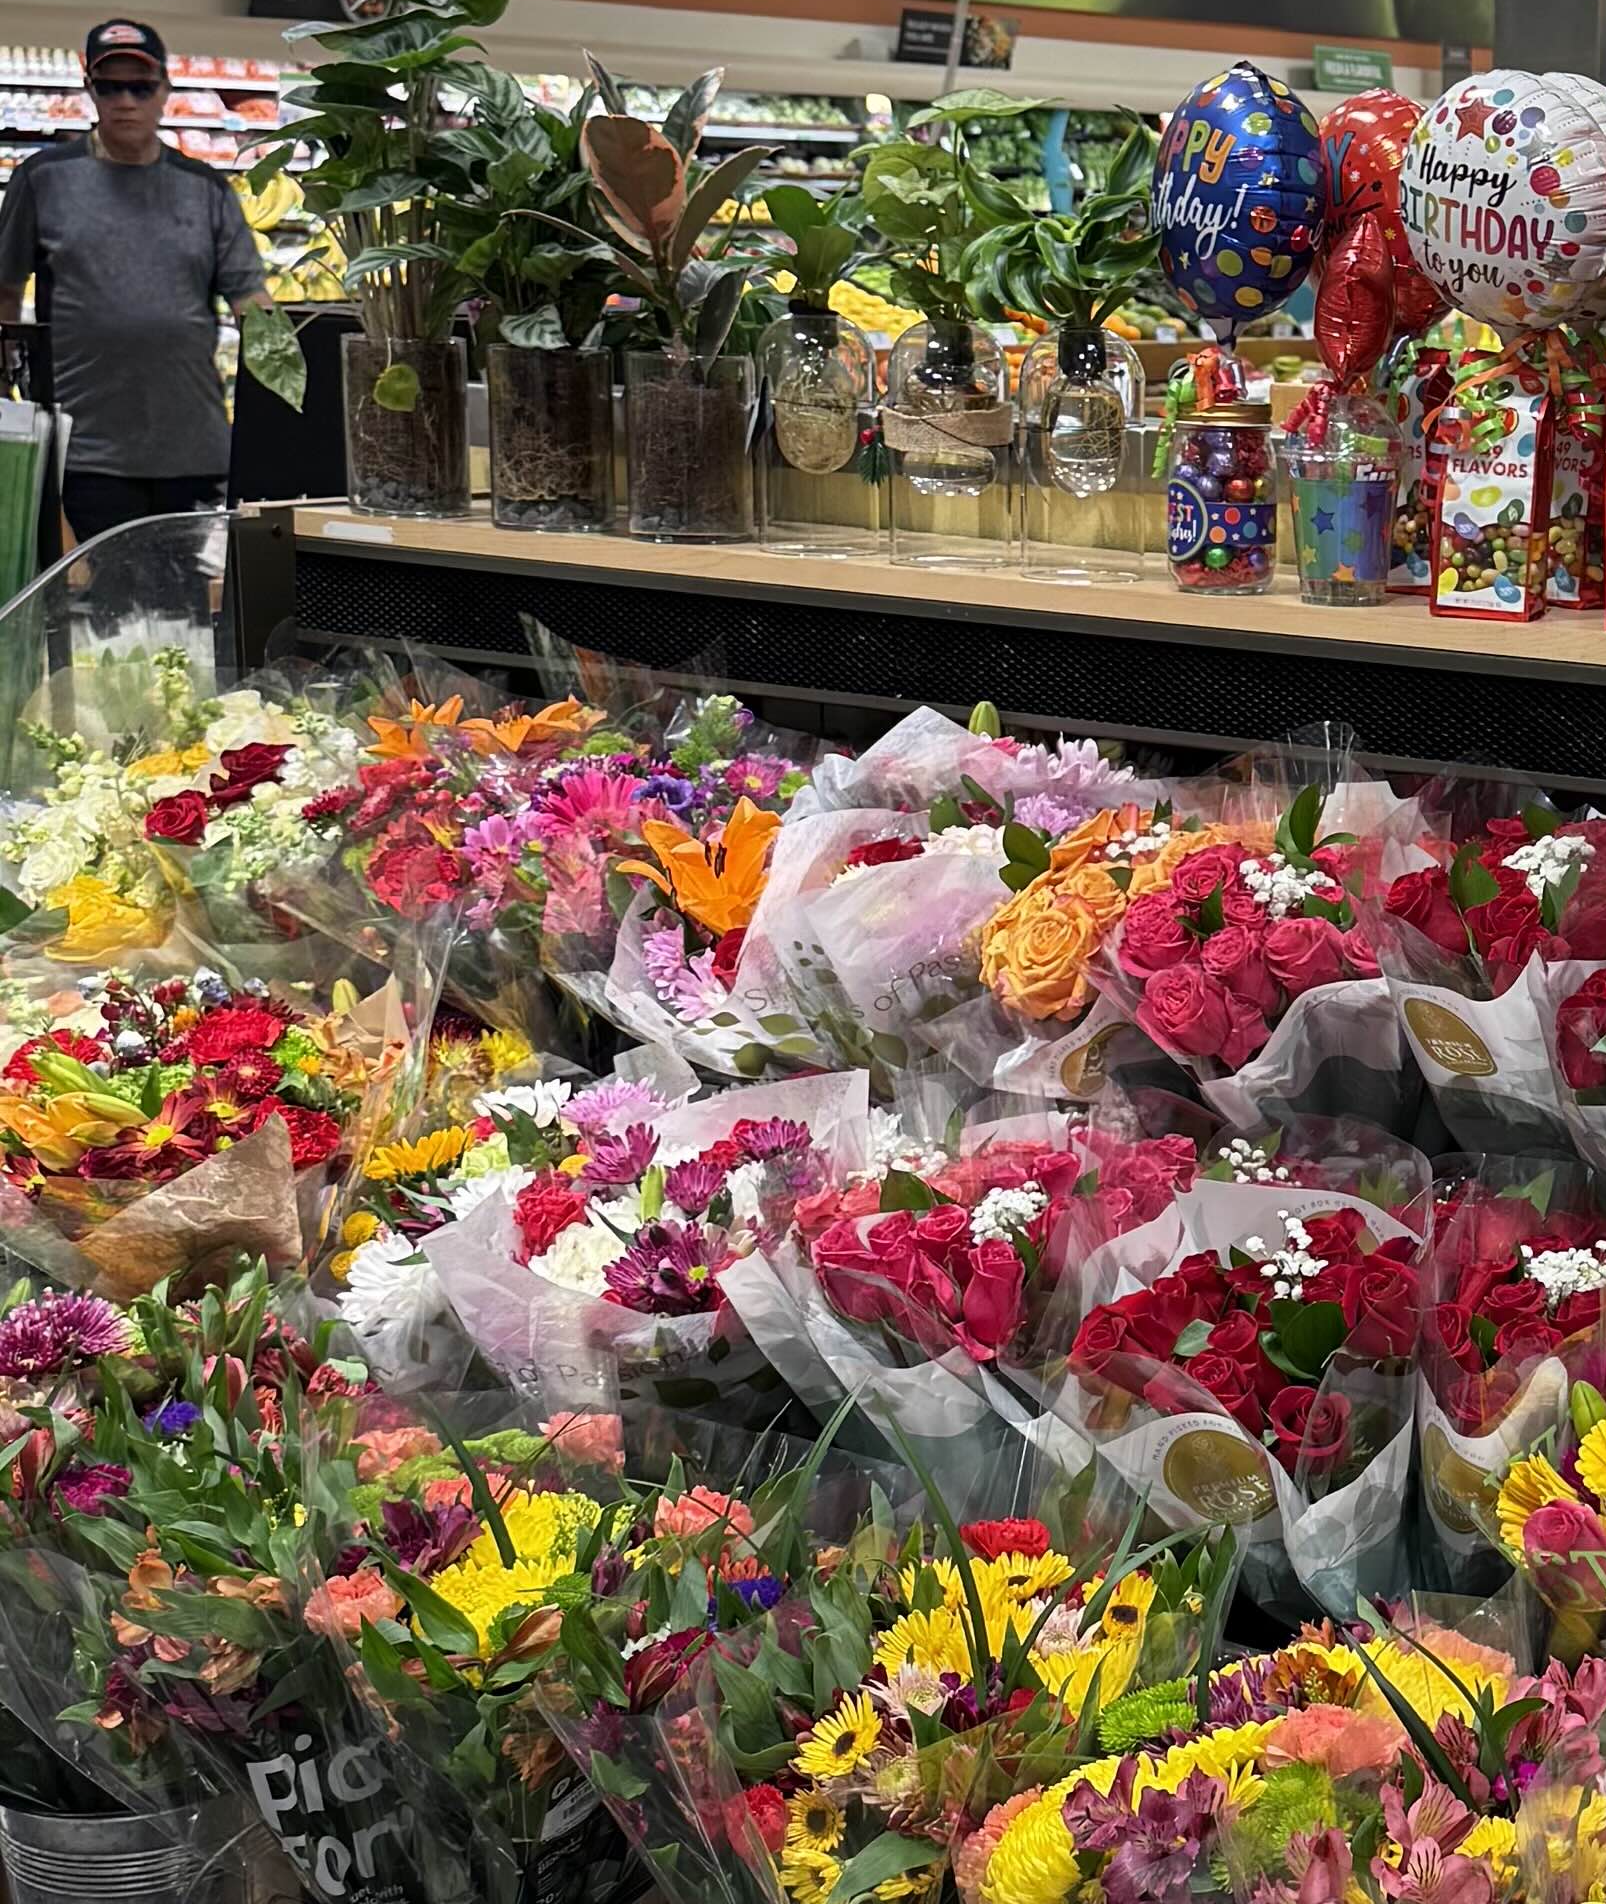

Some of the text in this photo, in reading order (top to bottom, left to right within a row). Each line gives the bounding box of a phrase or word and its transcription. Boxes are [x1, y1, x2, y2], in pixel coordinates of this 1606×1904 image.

[1160, 119, 1238, 185] PPY
[1418, 143, 1518, 208] Happy
[1400, 179, 1555, 261] BIRTHDAY
[1448, 257, 1506, 293] you
[1452, 457, 1529, 479] FLAVORS
